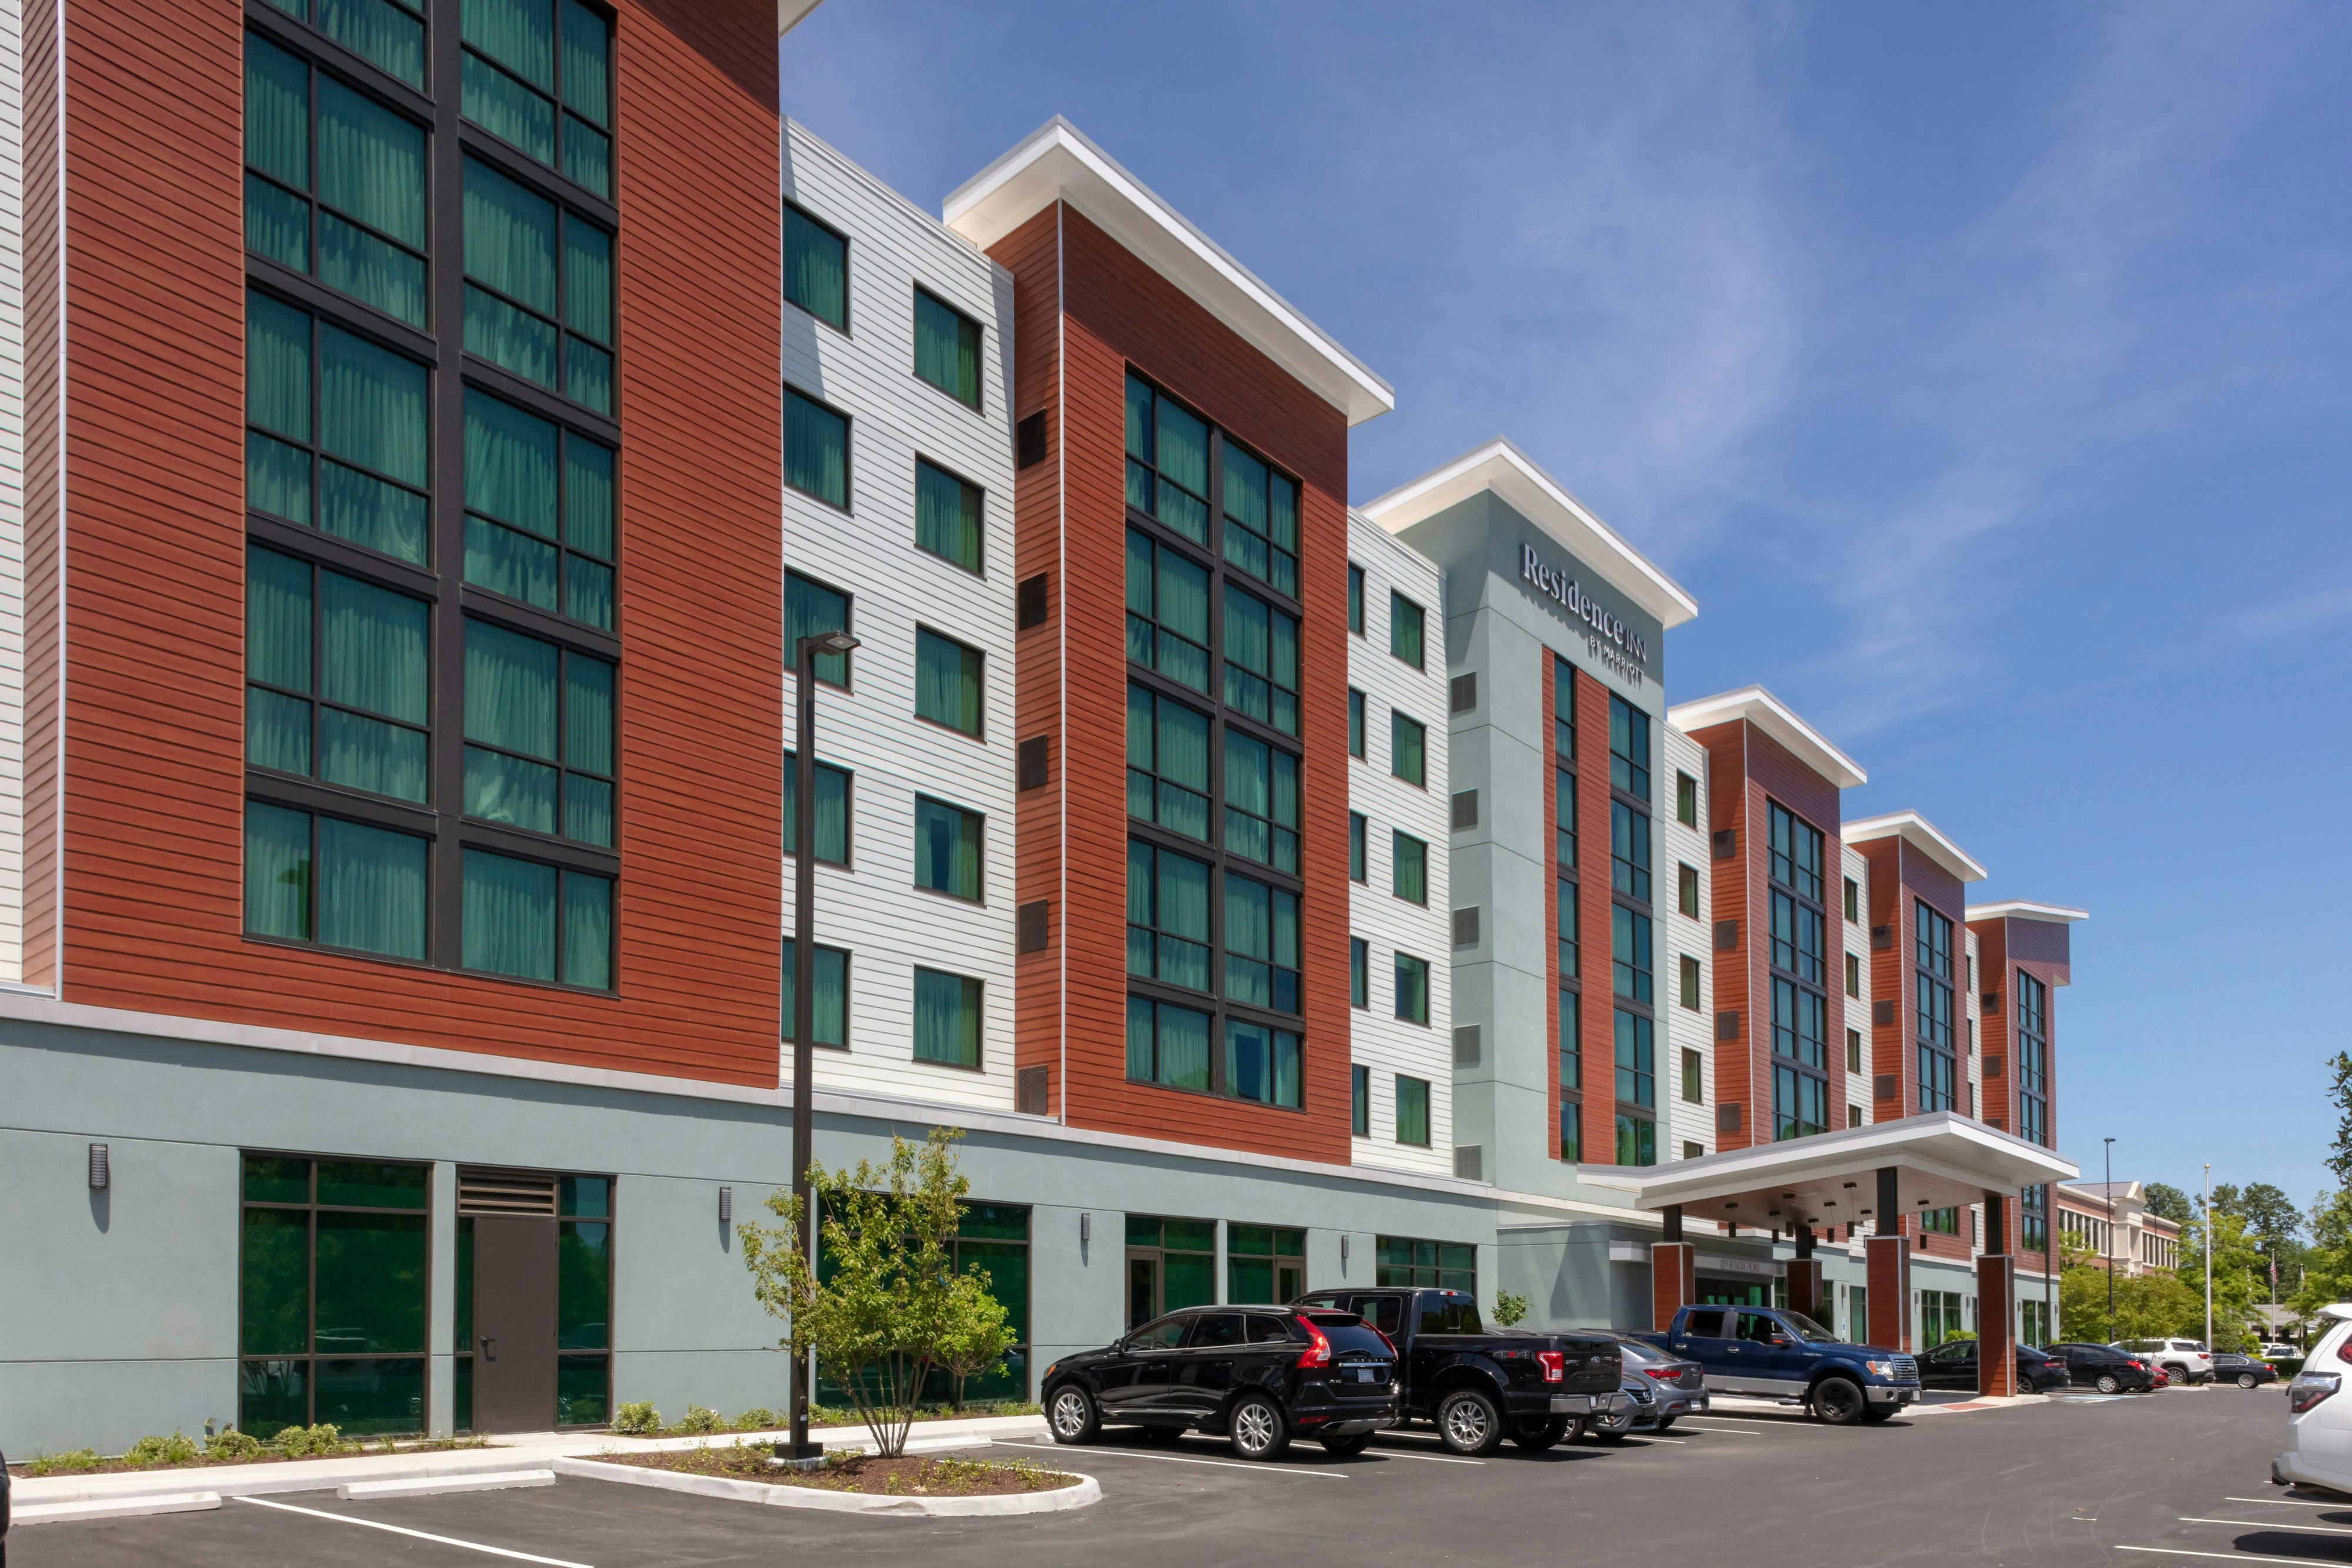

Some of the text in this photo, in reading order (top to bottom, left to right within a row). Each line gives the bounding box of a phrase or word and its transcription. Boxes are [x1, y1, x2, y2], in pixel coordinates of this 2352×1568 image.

[1521, 543, 1646, 663] Residence INN
[1590, 636, 1644, 680] BY MARRIOTT
